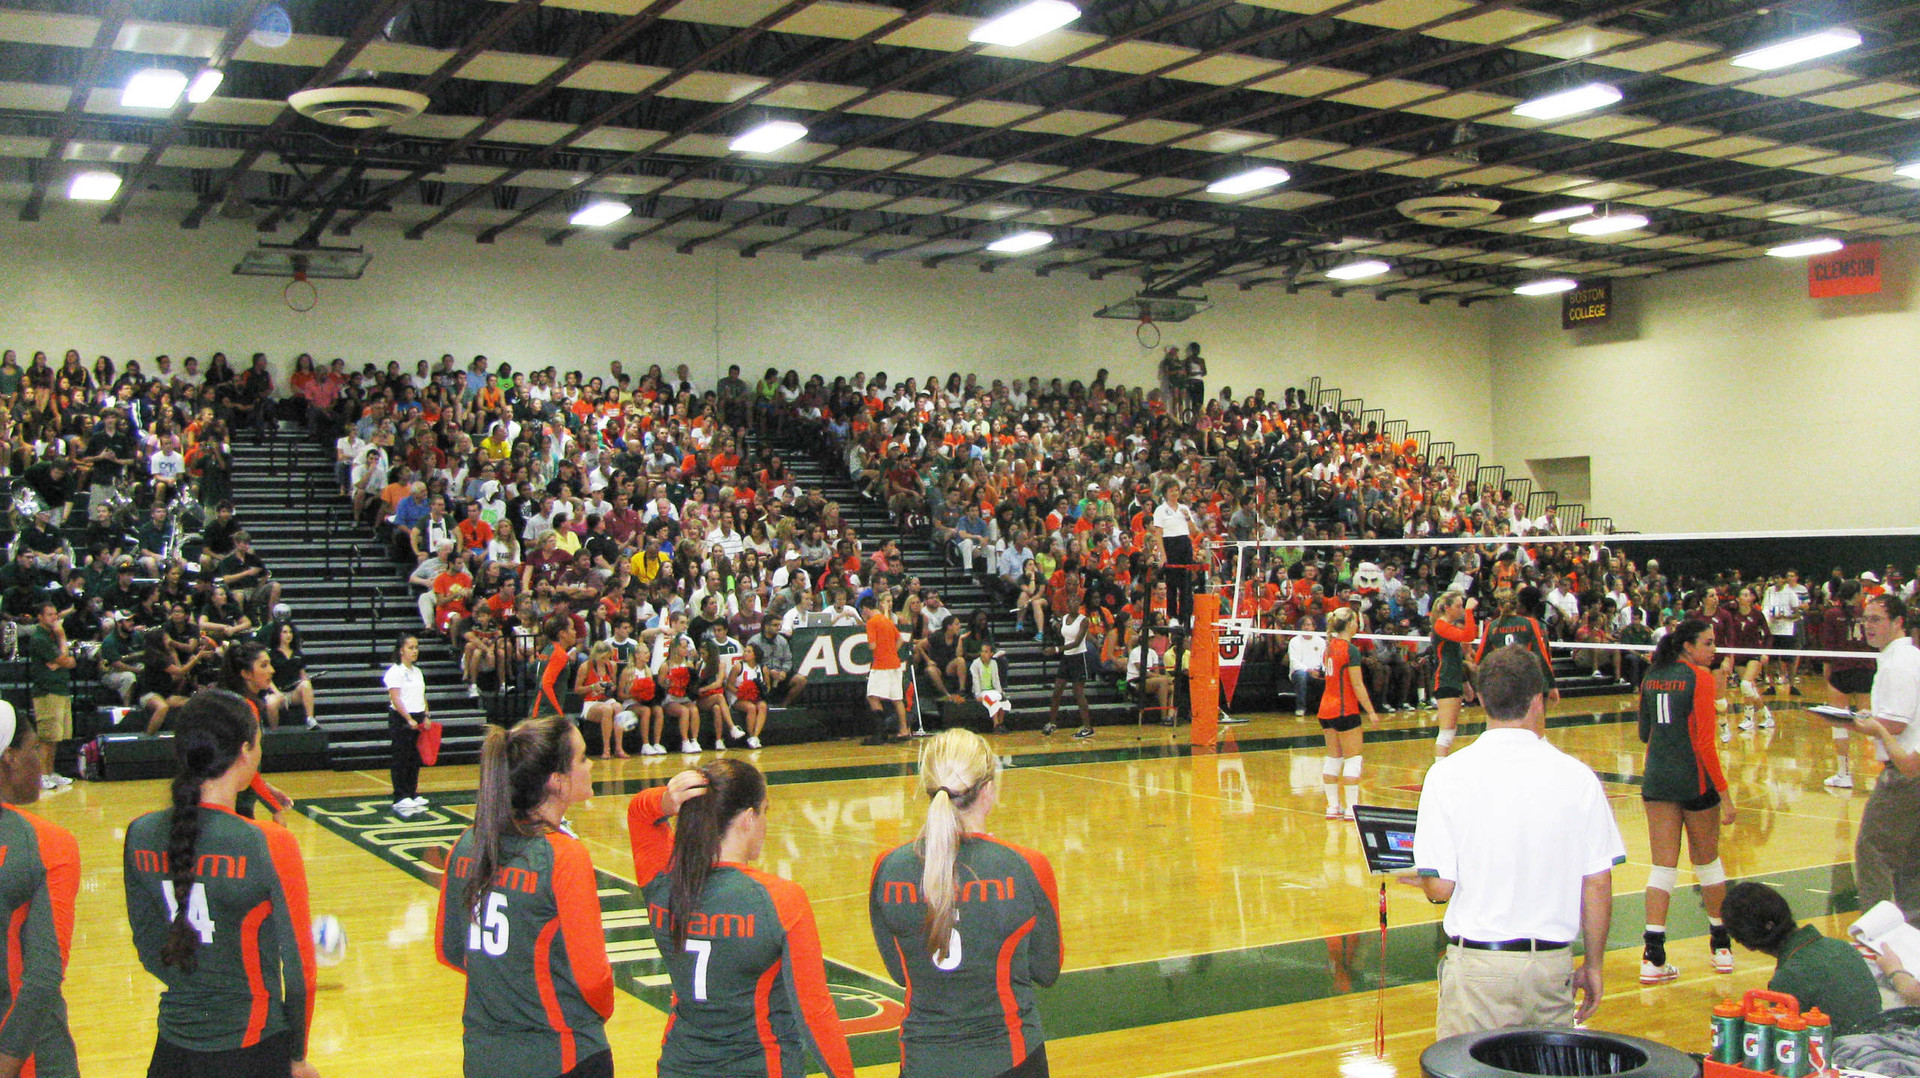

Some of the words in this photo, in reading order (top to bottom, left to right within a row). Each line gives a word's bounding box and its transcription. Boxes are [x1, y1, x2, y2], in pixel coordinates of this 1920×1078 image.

[1815, 259, 1875, 281] CLEMSON
[1569, 288, 1605, 303] BOSTON
[1569, 304, 1606, 320] COLLEGE
[1656, 693, 1671, 723] 11
[134, 849, 248, 879] mimi
[684, 938, 712, 1000] 7
[1743, 1033, 1759, 1057] G
[1776, 1039, 1795, 1063] G
